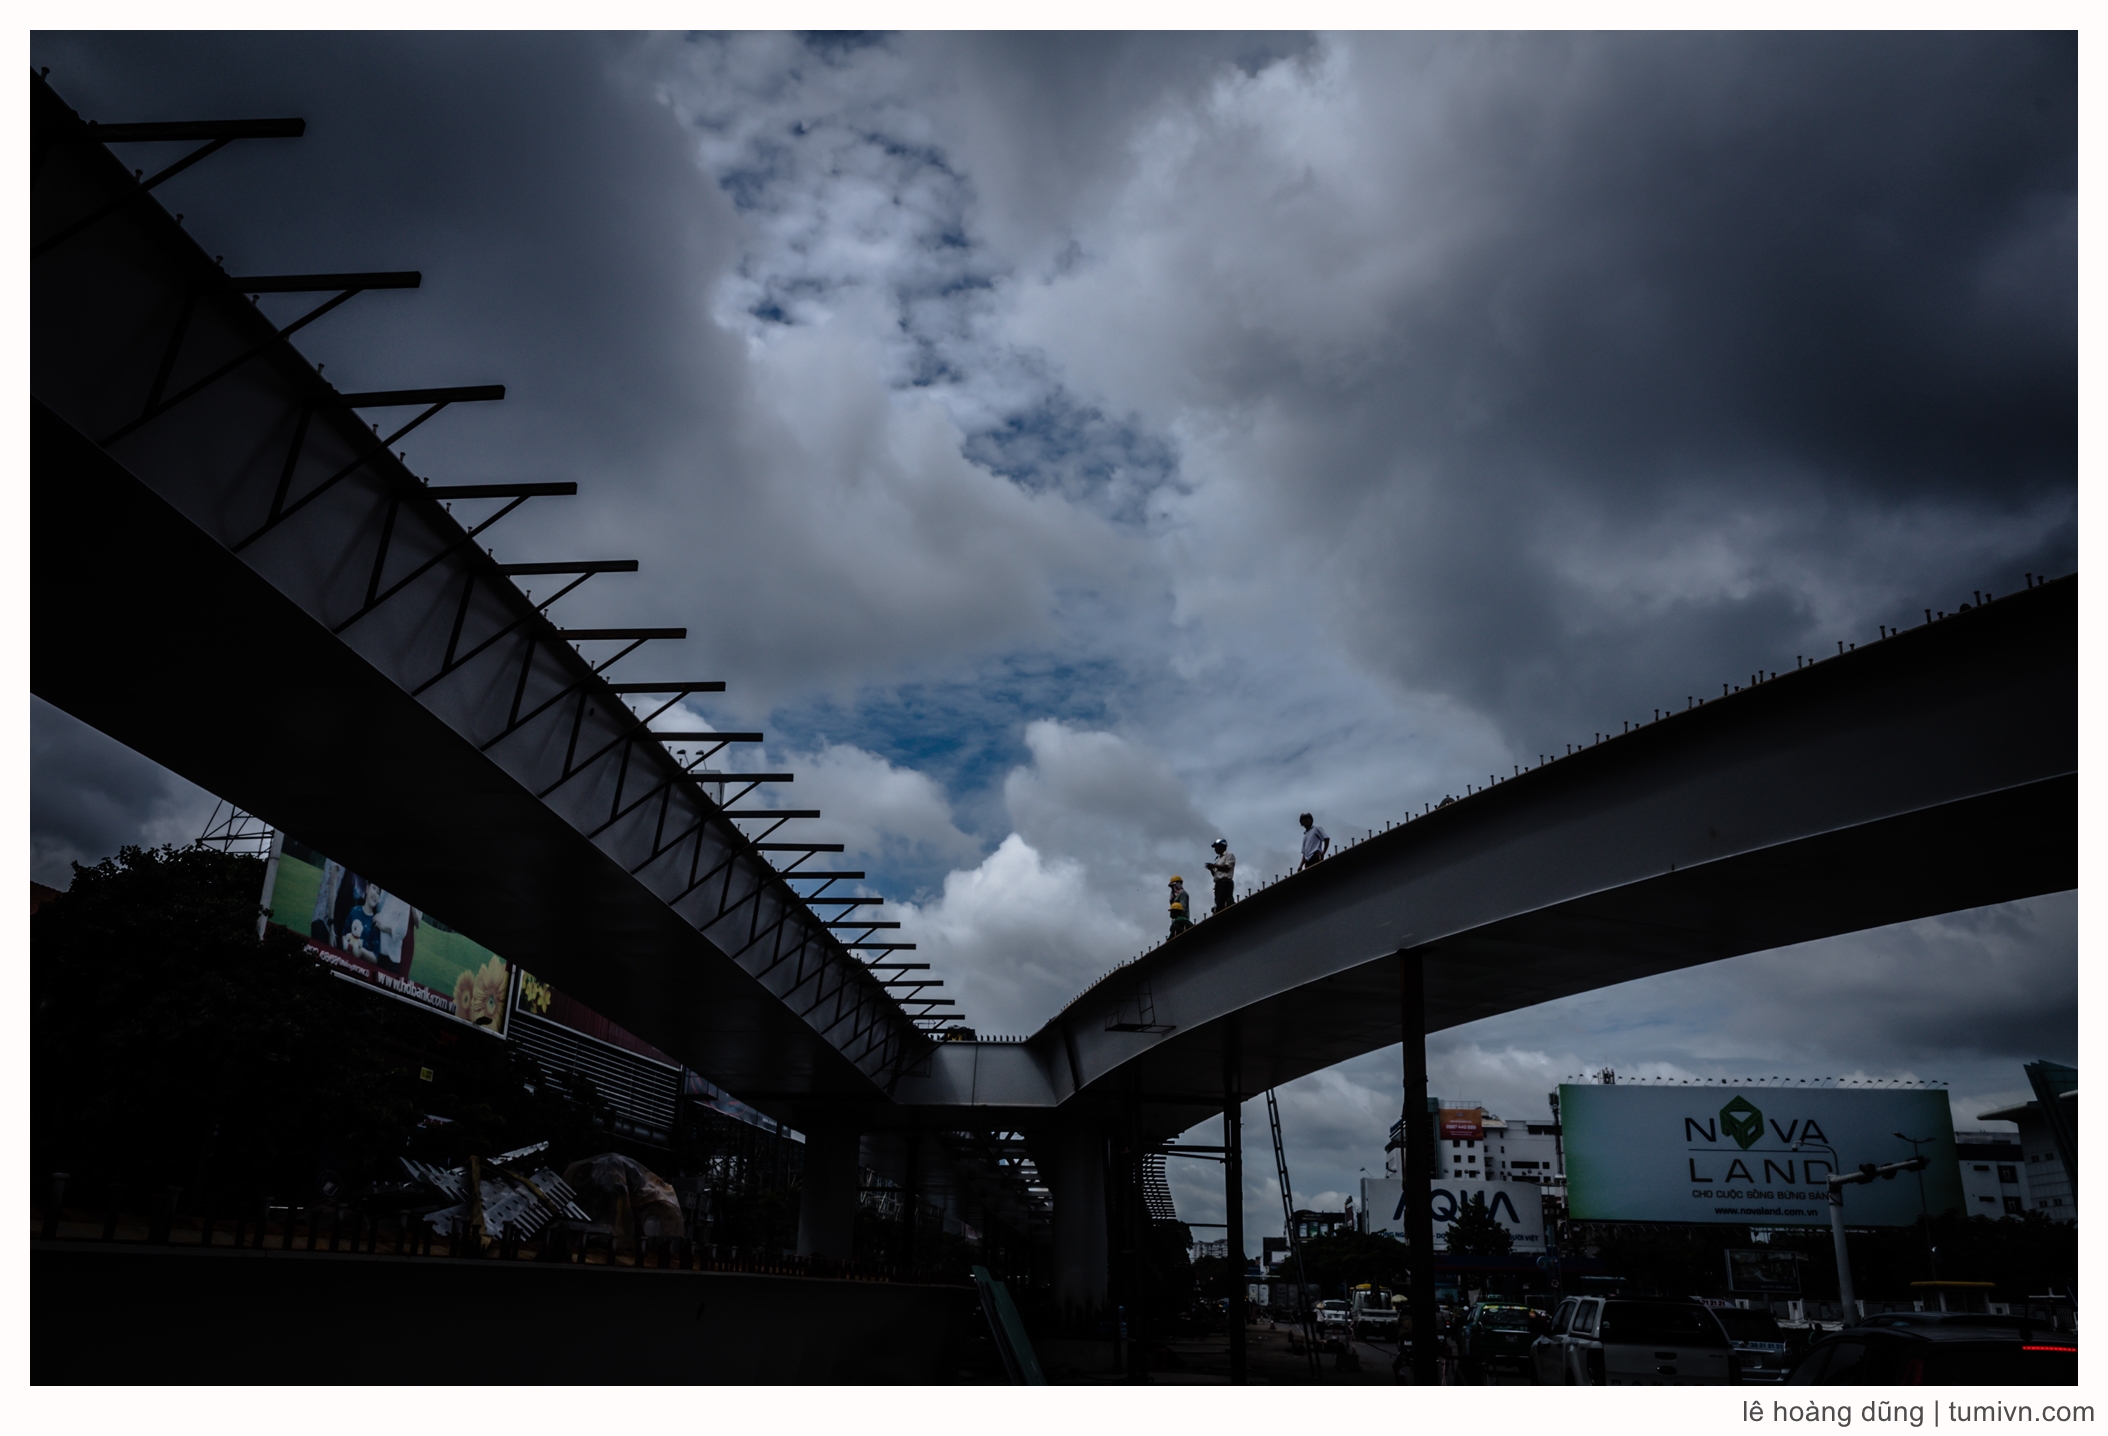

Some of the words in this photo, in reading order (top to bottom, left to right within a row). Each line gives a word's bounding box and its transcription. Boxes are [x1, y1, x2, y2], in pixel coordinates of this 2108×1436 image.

[1689, 1158, 1833, 1185] LAND
[1692, 1189, 1713, 1198] CHO
[1716, 1188, 1744, 1200] CUỘC
[1714, 1206, 1818, 1216] www.novaland.com.vn
